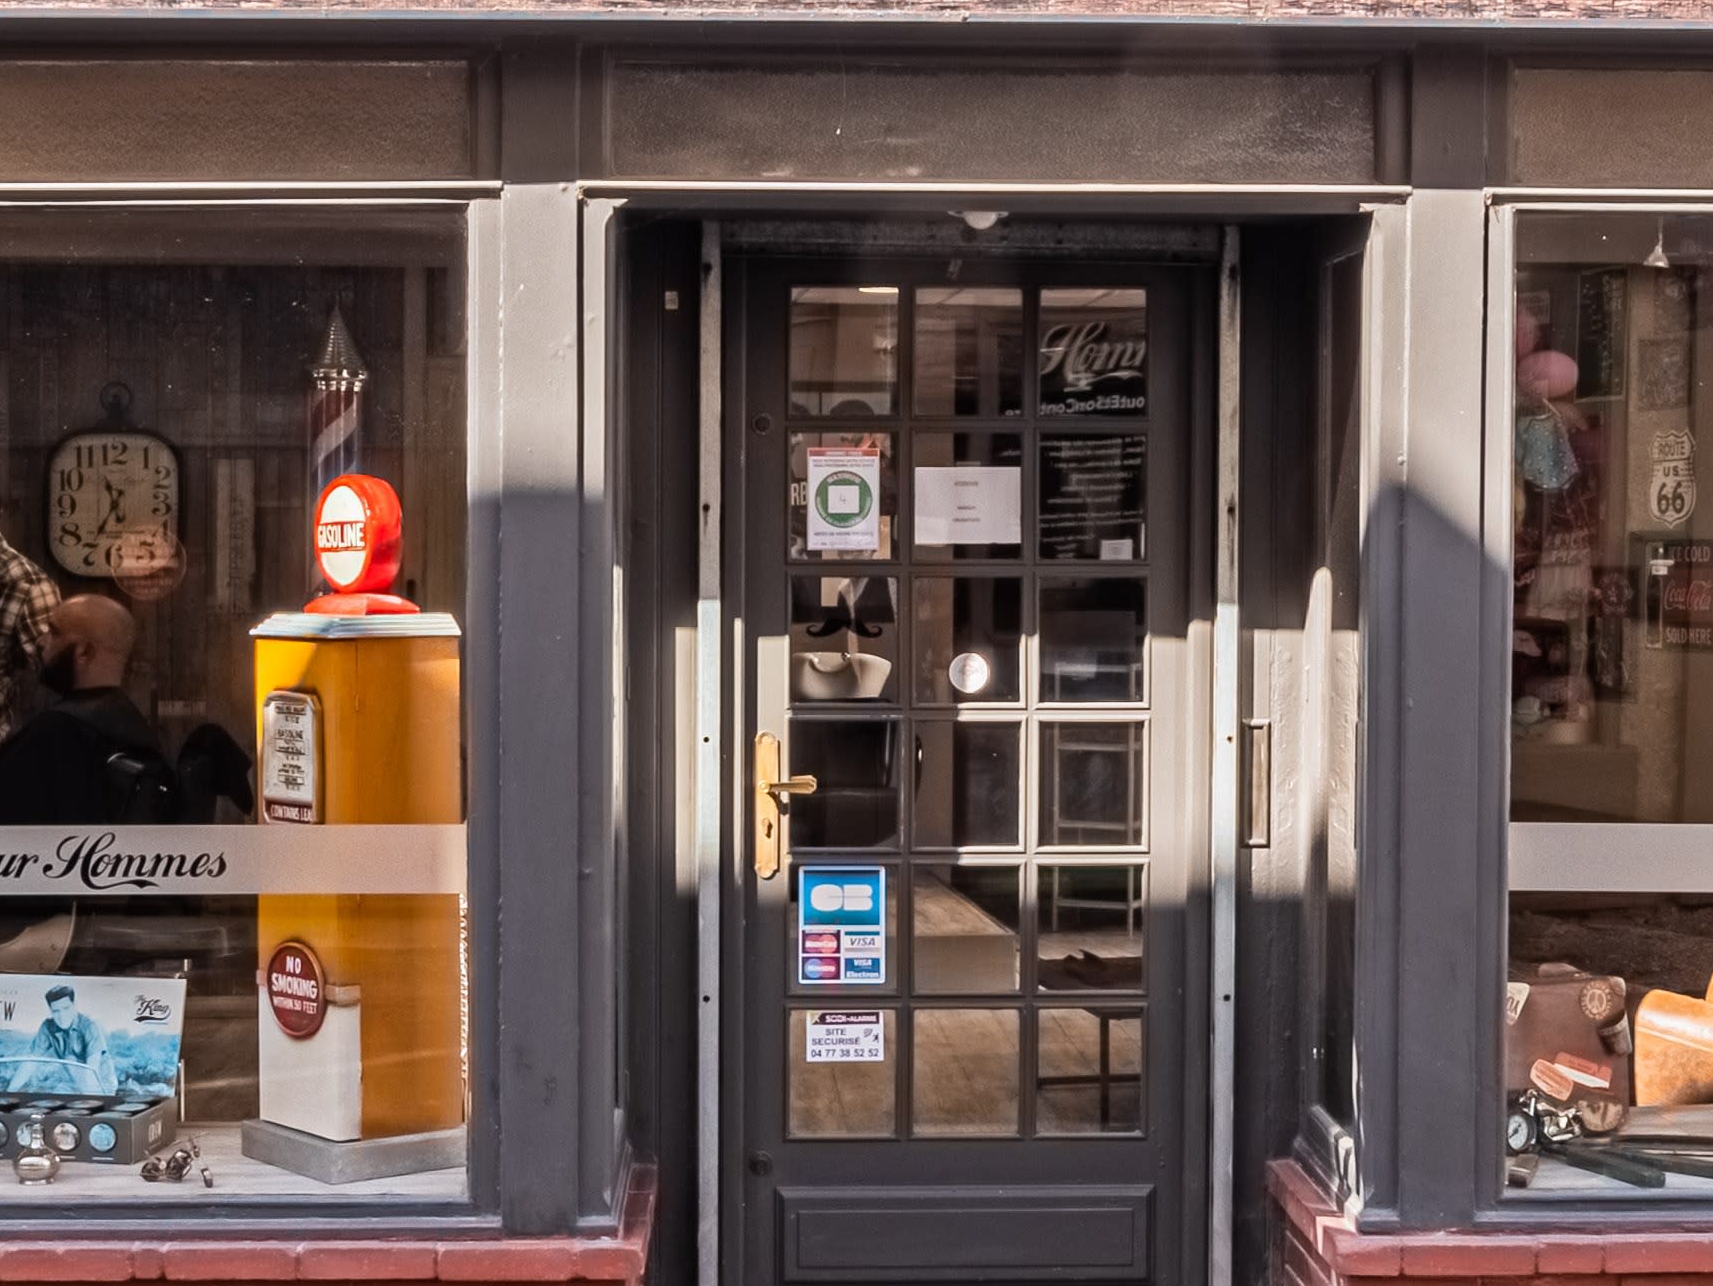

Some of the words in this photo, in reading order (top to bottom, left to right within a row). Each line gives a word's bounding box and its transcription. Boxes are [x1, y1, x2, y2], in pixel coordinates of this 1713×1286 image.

[102, 442, 128, 466] 12
[60, 468, 84, 492] 10
[154, 466, 171, 490] 2
[1663, 466, 1679, 476] US
[57, 494, 77, 519] 9
[152, 491, 172, 516] 3
[1656, 482, 1686, 515] 66
[59, 522, 82, 548] 8
[317, 522, 366, 549] GASOLINE
[43, 831, 229, 890] Hommes
[810, 884, 874, 912] CB
[849, 937, 876, 946] VISA
[286, 955, 302, 974] NO
[271, 972, 318, 1000] SMOKING
[825, 1028, 847, 1036] SITE
[810, 1048, 822, 1058] 04
[825, 1048, 837, 1058] 77
[839, 1048, 852, 1058] 38
[853, 1048, 866, 1058] 52
[868, 1048, 880, 1058] 52
